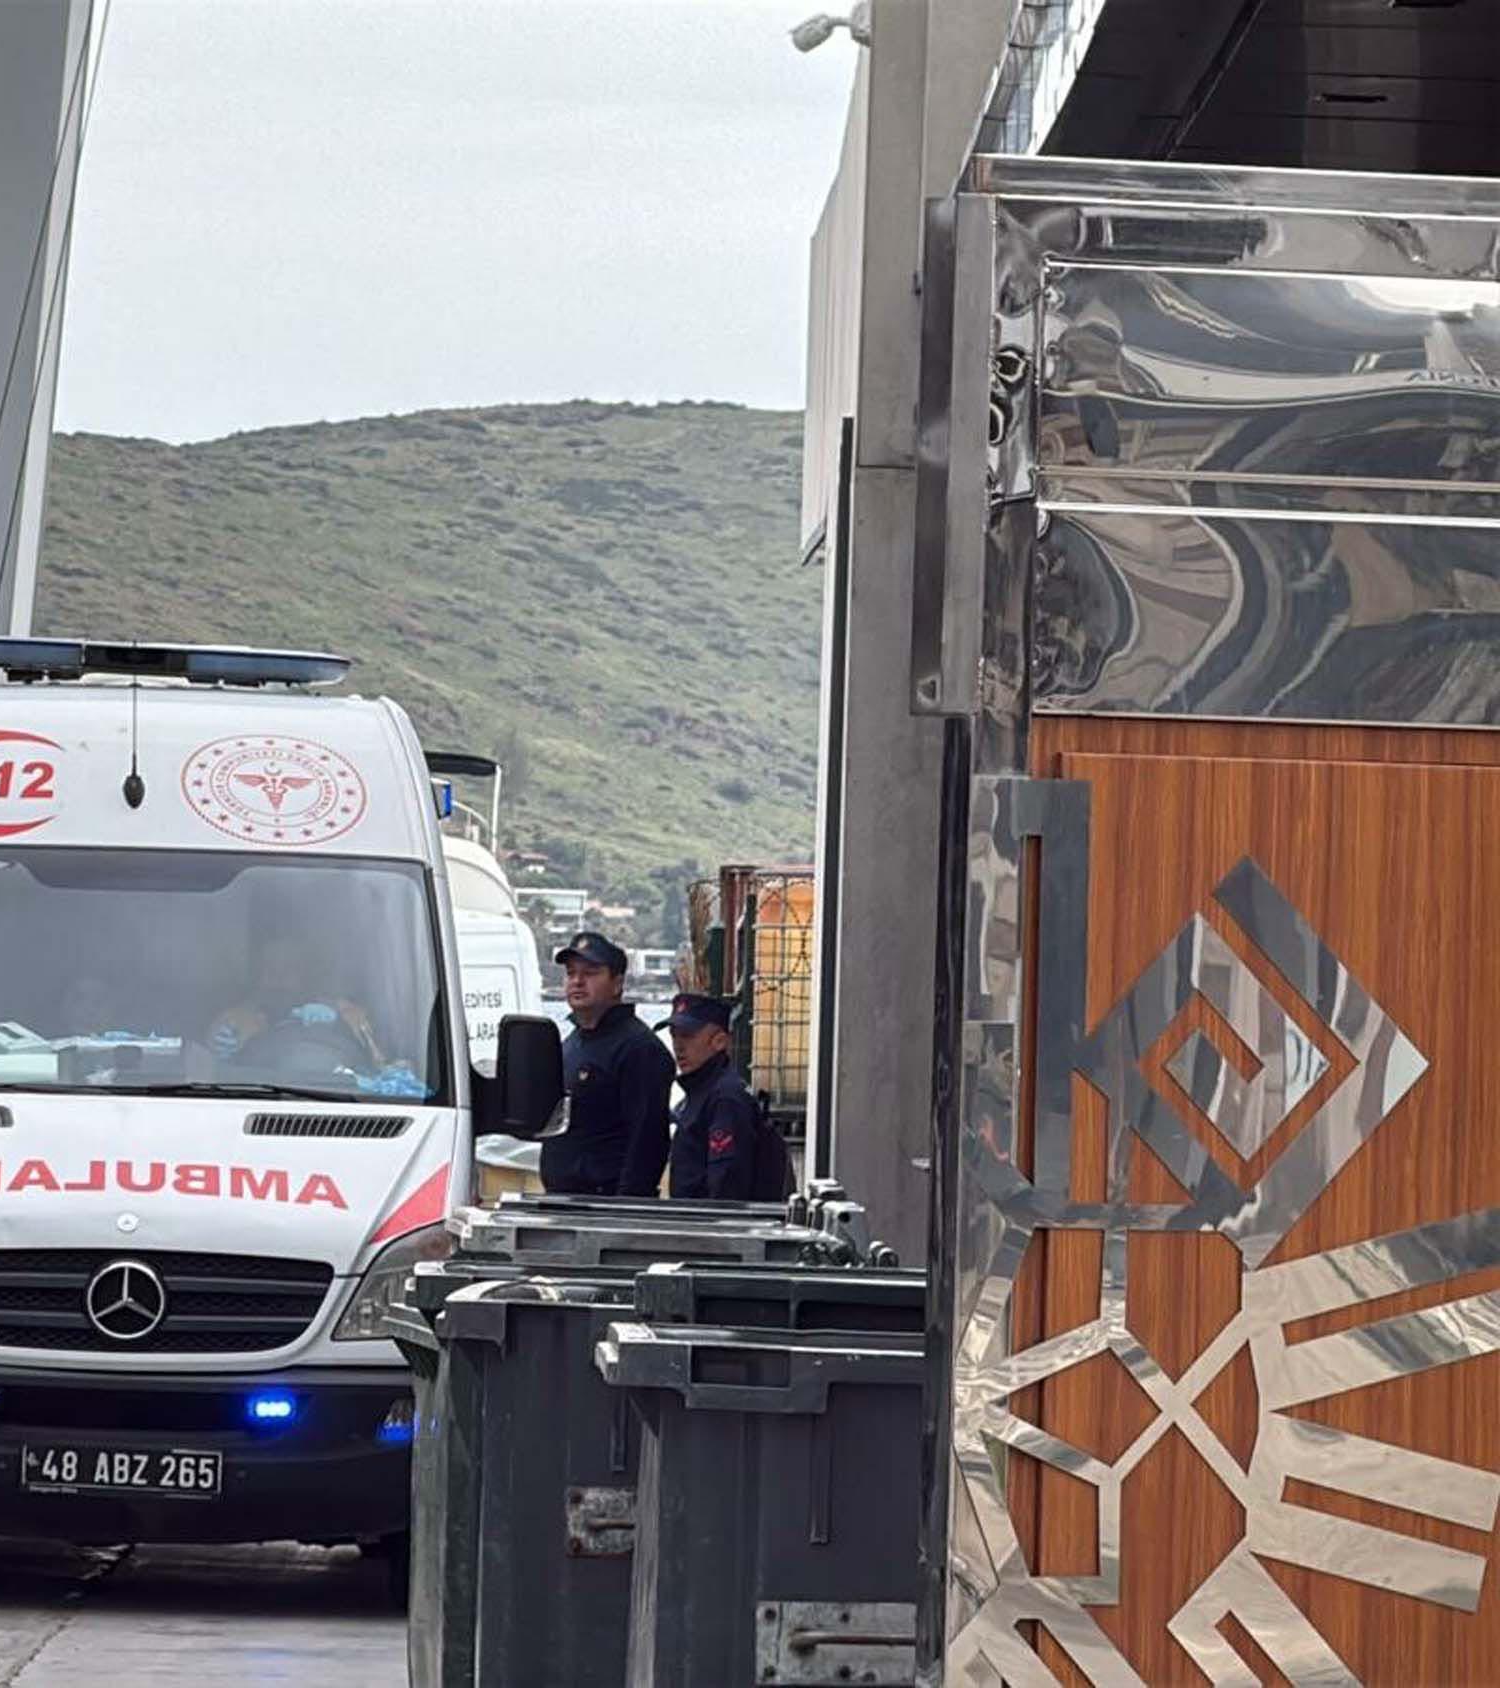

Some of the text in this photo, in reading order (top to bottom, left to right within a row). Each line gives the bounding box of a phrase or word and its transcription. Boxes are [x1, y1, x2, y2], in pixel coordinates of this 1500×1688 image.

[42, 1449, 215, 1489] 48 ABZ 265
